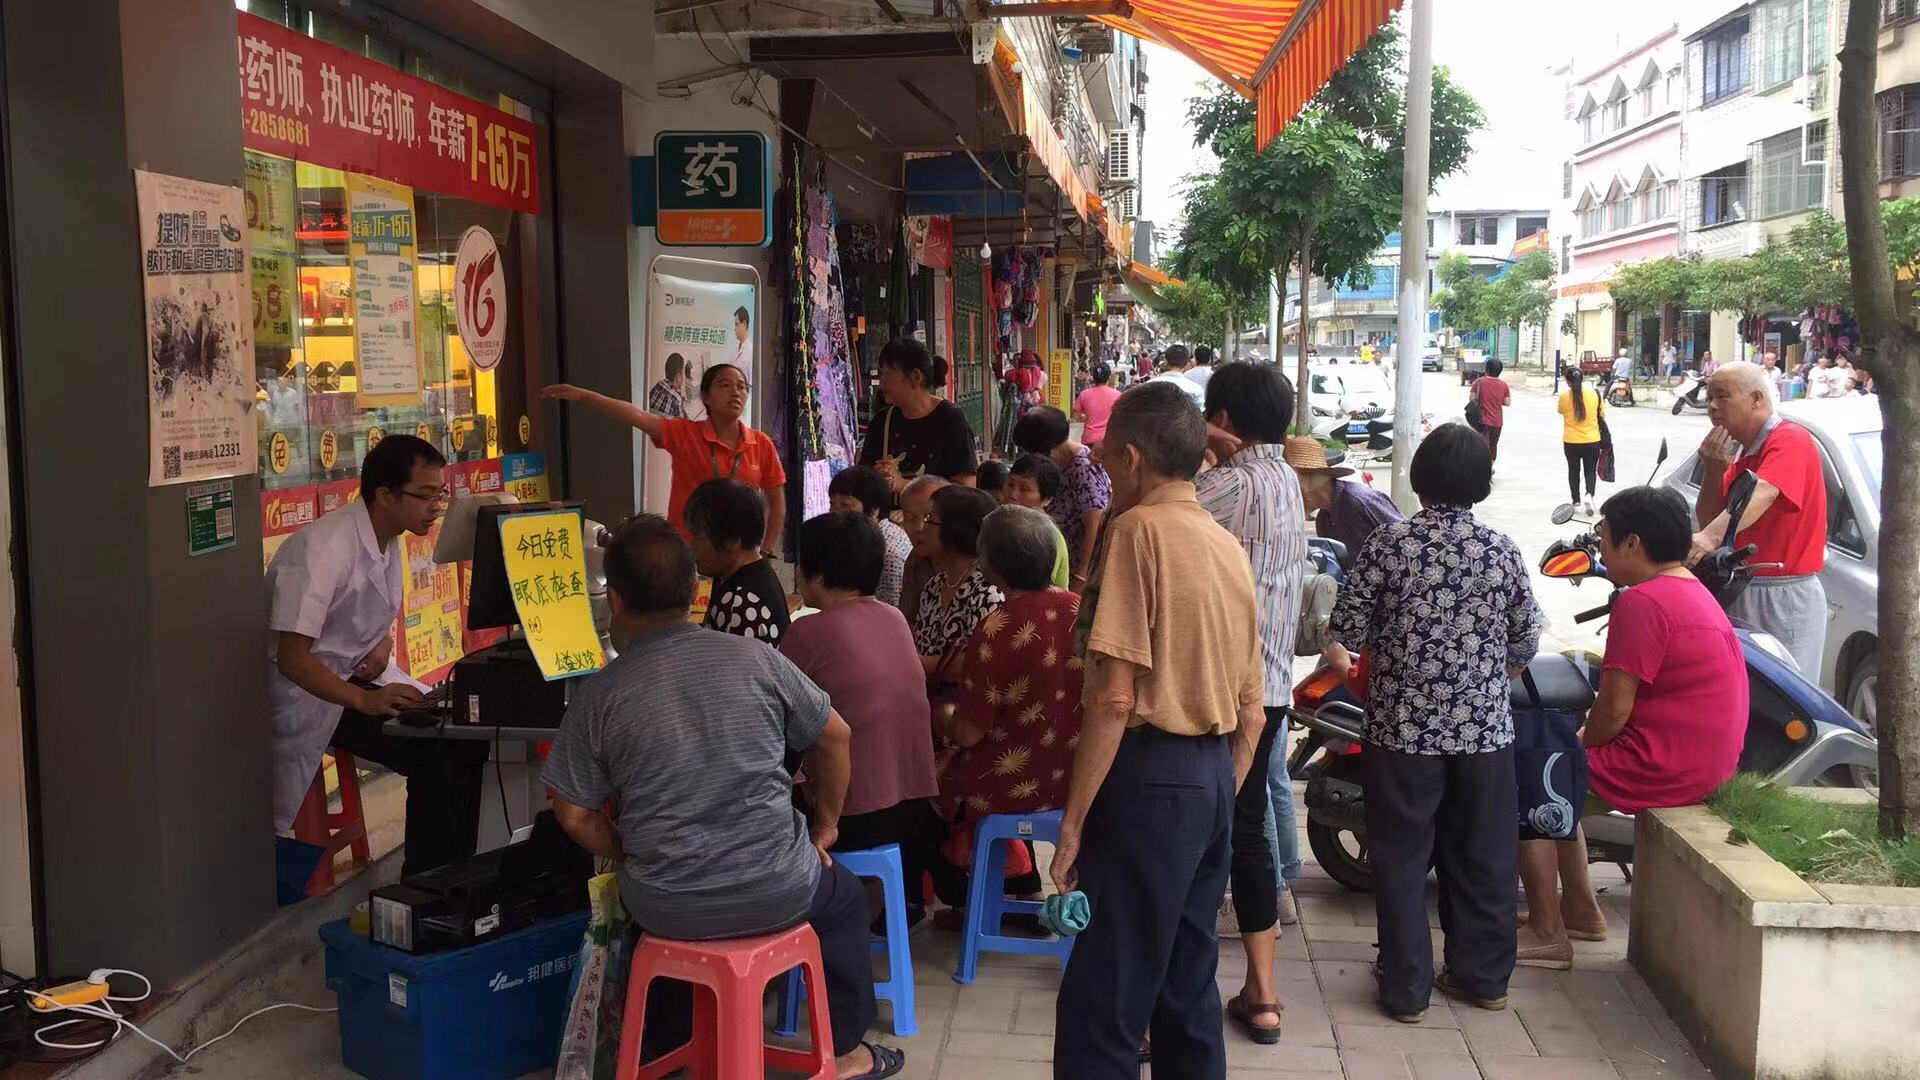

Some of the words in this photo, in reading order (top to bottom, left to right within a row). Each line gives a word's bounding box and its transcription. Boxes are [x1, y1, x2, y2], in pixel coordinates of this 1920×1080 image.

[681, 142, 739, 197] 药
[664, 326, 727, 345] 糖网筛查早知道
[517, 527, 573, 560] 今日免费
[514, 570, 585, 606] 眼底检查
